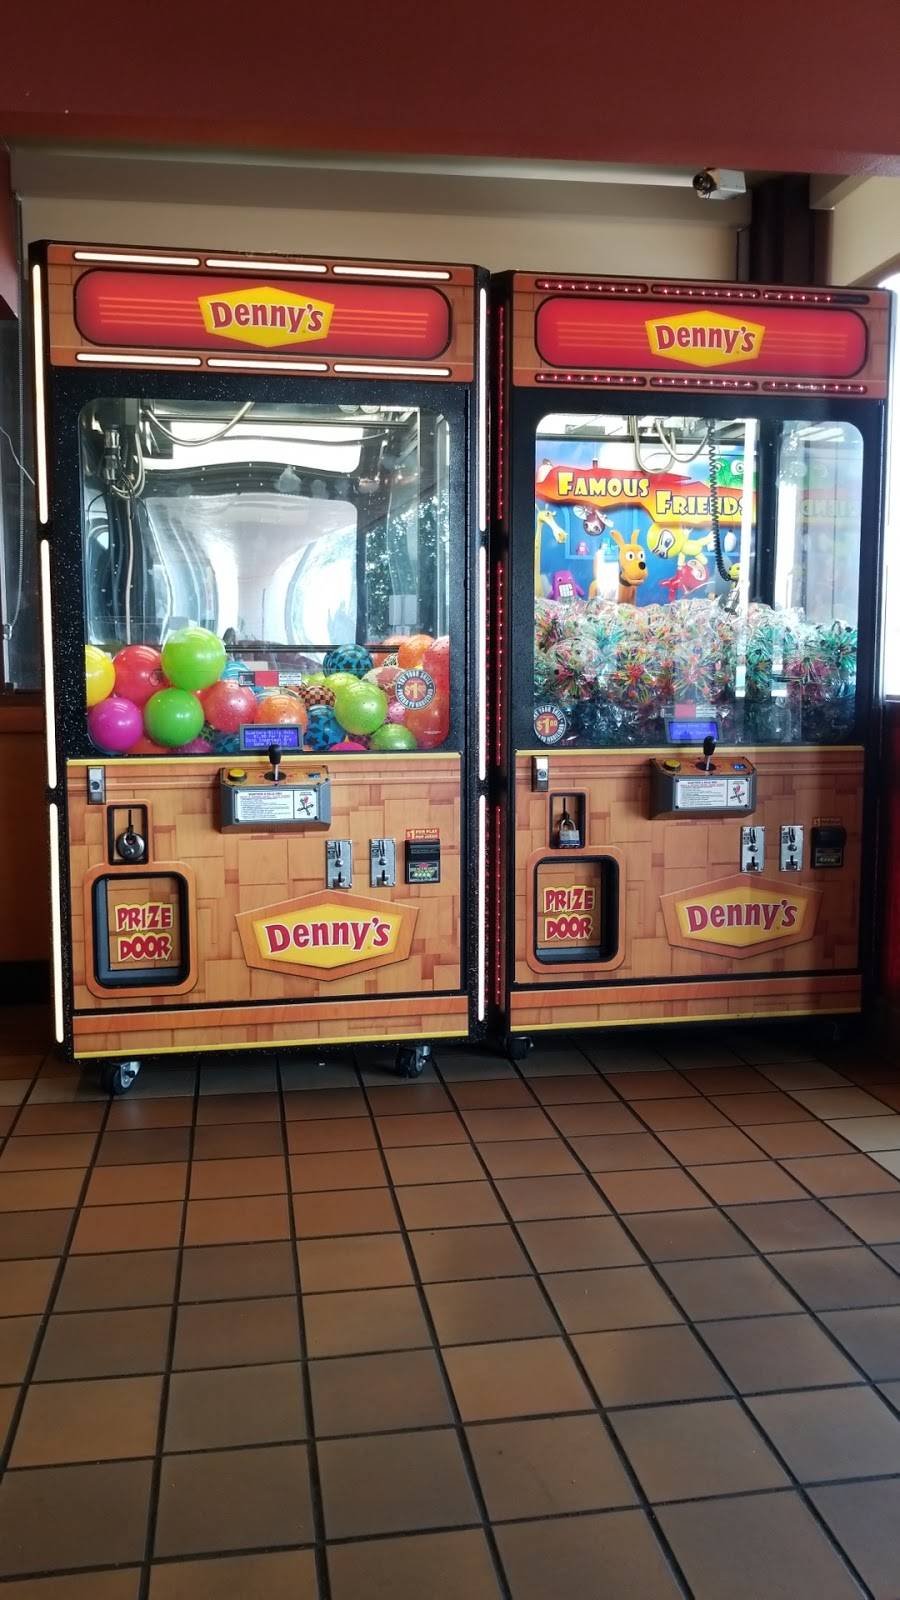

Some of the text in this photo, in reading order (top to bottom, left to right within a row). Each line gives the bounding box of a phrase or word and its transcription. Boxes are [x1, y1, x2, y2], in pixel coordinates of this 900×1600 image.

[209, 301, 324, 334] Denny's
[655, 324, 755, 354] Denny's
[544, 886, 595, 912] PRIZE
[116, 903, 172, 931] PRIZE
[545, 914, 593, 940] DOOR
[687, 899, 797, 932] Denny's
[118, 933, 172, 961] DOOR
[264, 917, 390, 952] Denny's
